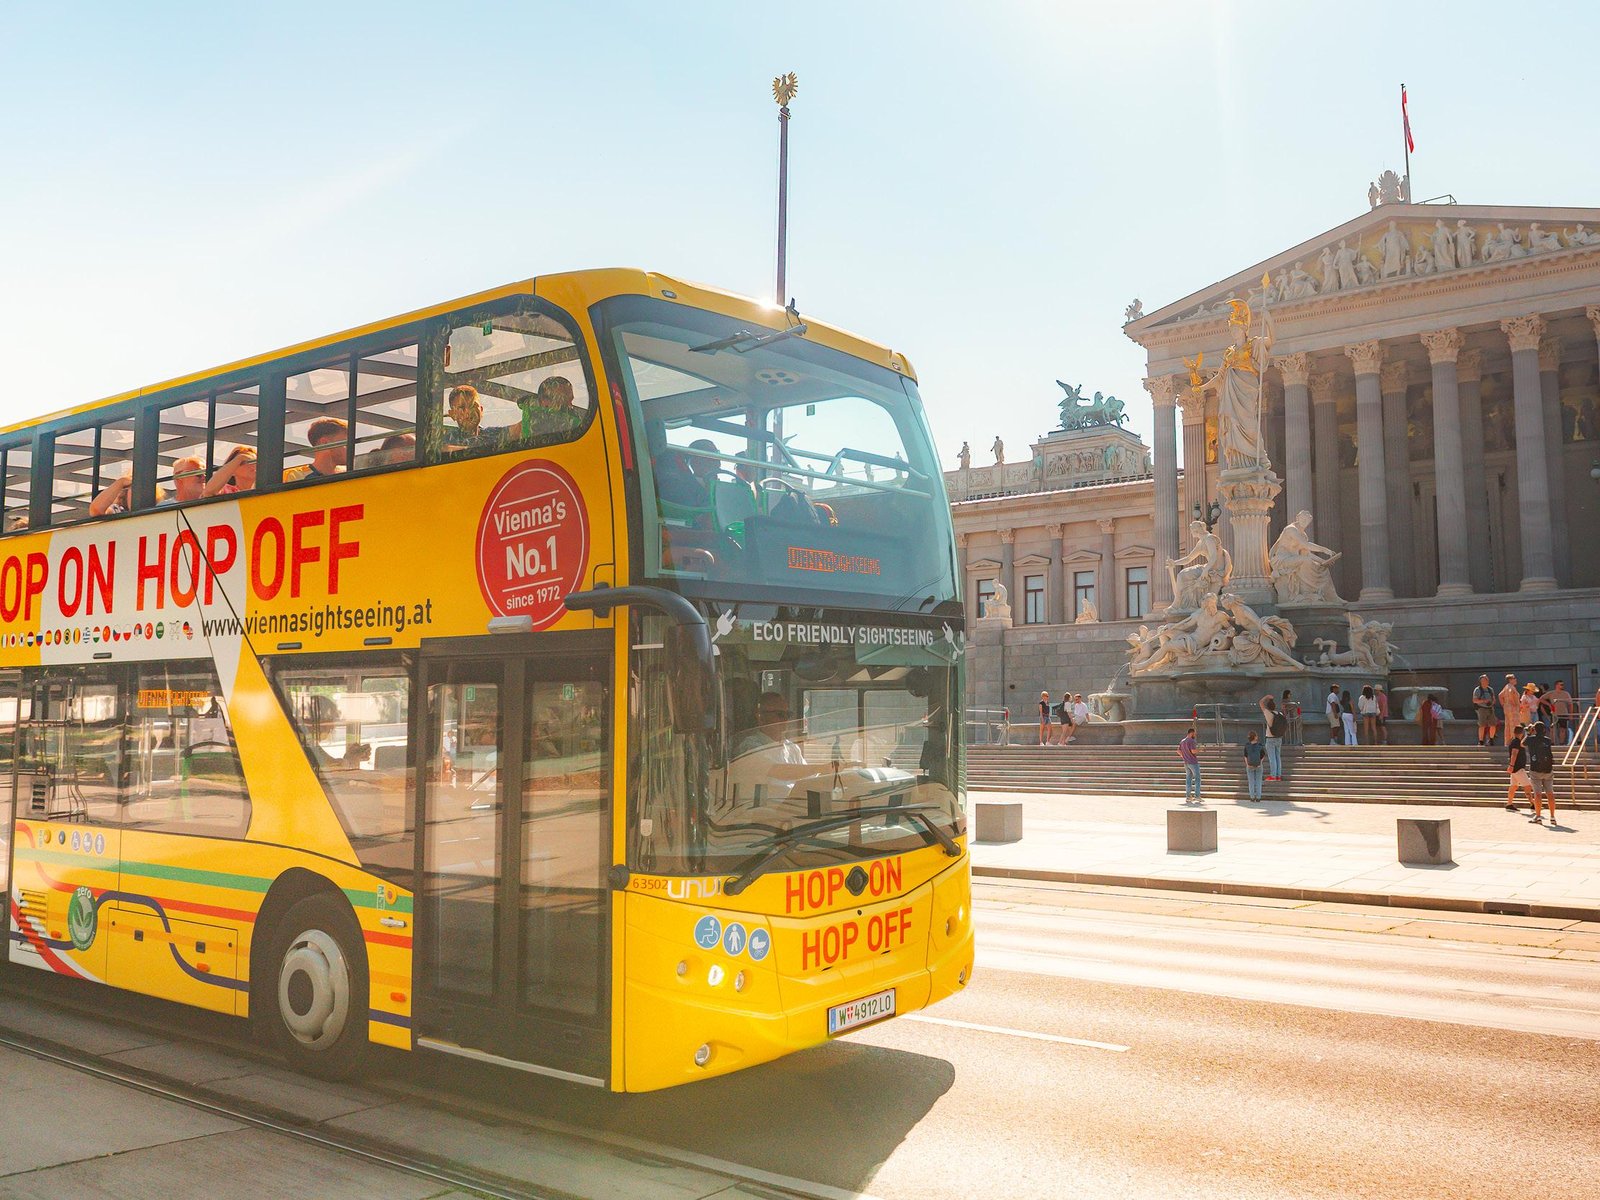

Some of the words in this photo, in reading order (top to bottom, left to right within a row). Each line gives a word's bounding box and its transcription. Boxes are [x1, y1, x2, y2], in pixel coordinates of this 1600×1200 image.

[494, 498, 567, 535] Vienna's
[58, 541, 116, 618] ON
[136, 524, 238, 612] HOP
[251, 504, 365, 602] OFF
[505, 535, 558, 581] No.1
[506, 594, 534, 610] since
[536, 585, 561, 605] 1972
[203, 599, 433, 638] www.viennasightseeing.at
[753, 623, 783, 642] ECO
[788, 624, 855, 644] FRIENDLY
[858, 628, 934, 646] SIGHTSEEING
[77, 886, 92, 899] zero
[632, 878, 668, 890] 63502
[786, 867, 844, 914] HOP
[869, 856, 902, 897] ON
[802, 921, 859, 971] HOP
[867, 907, 913, 952] OFF
[839, 1008, 847, 1026] W
